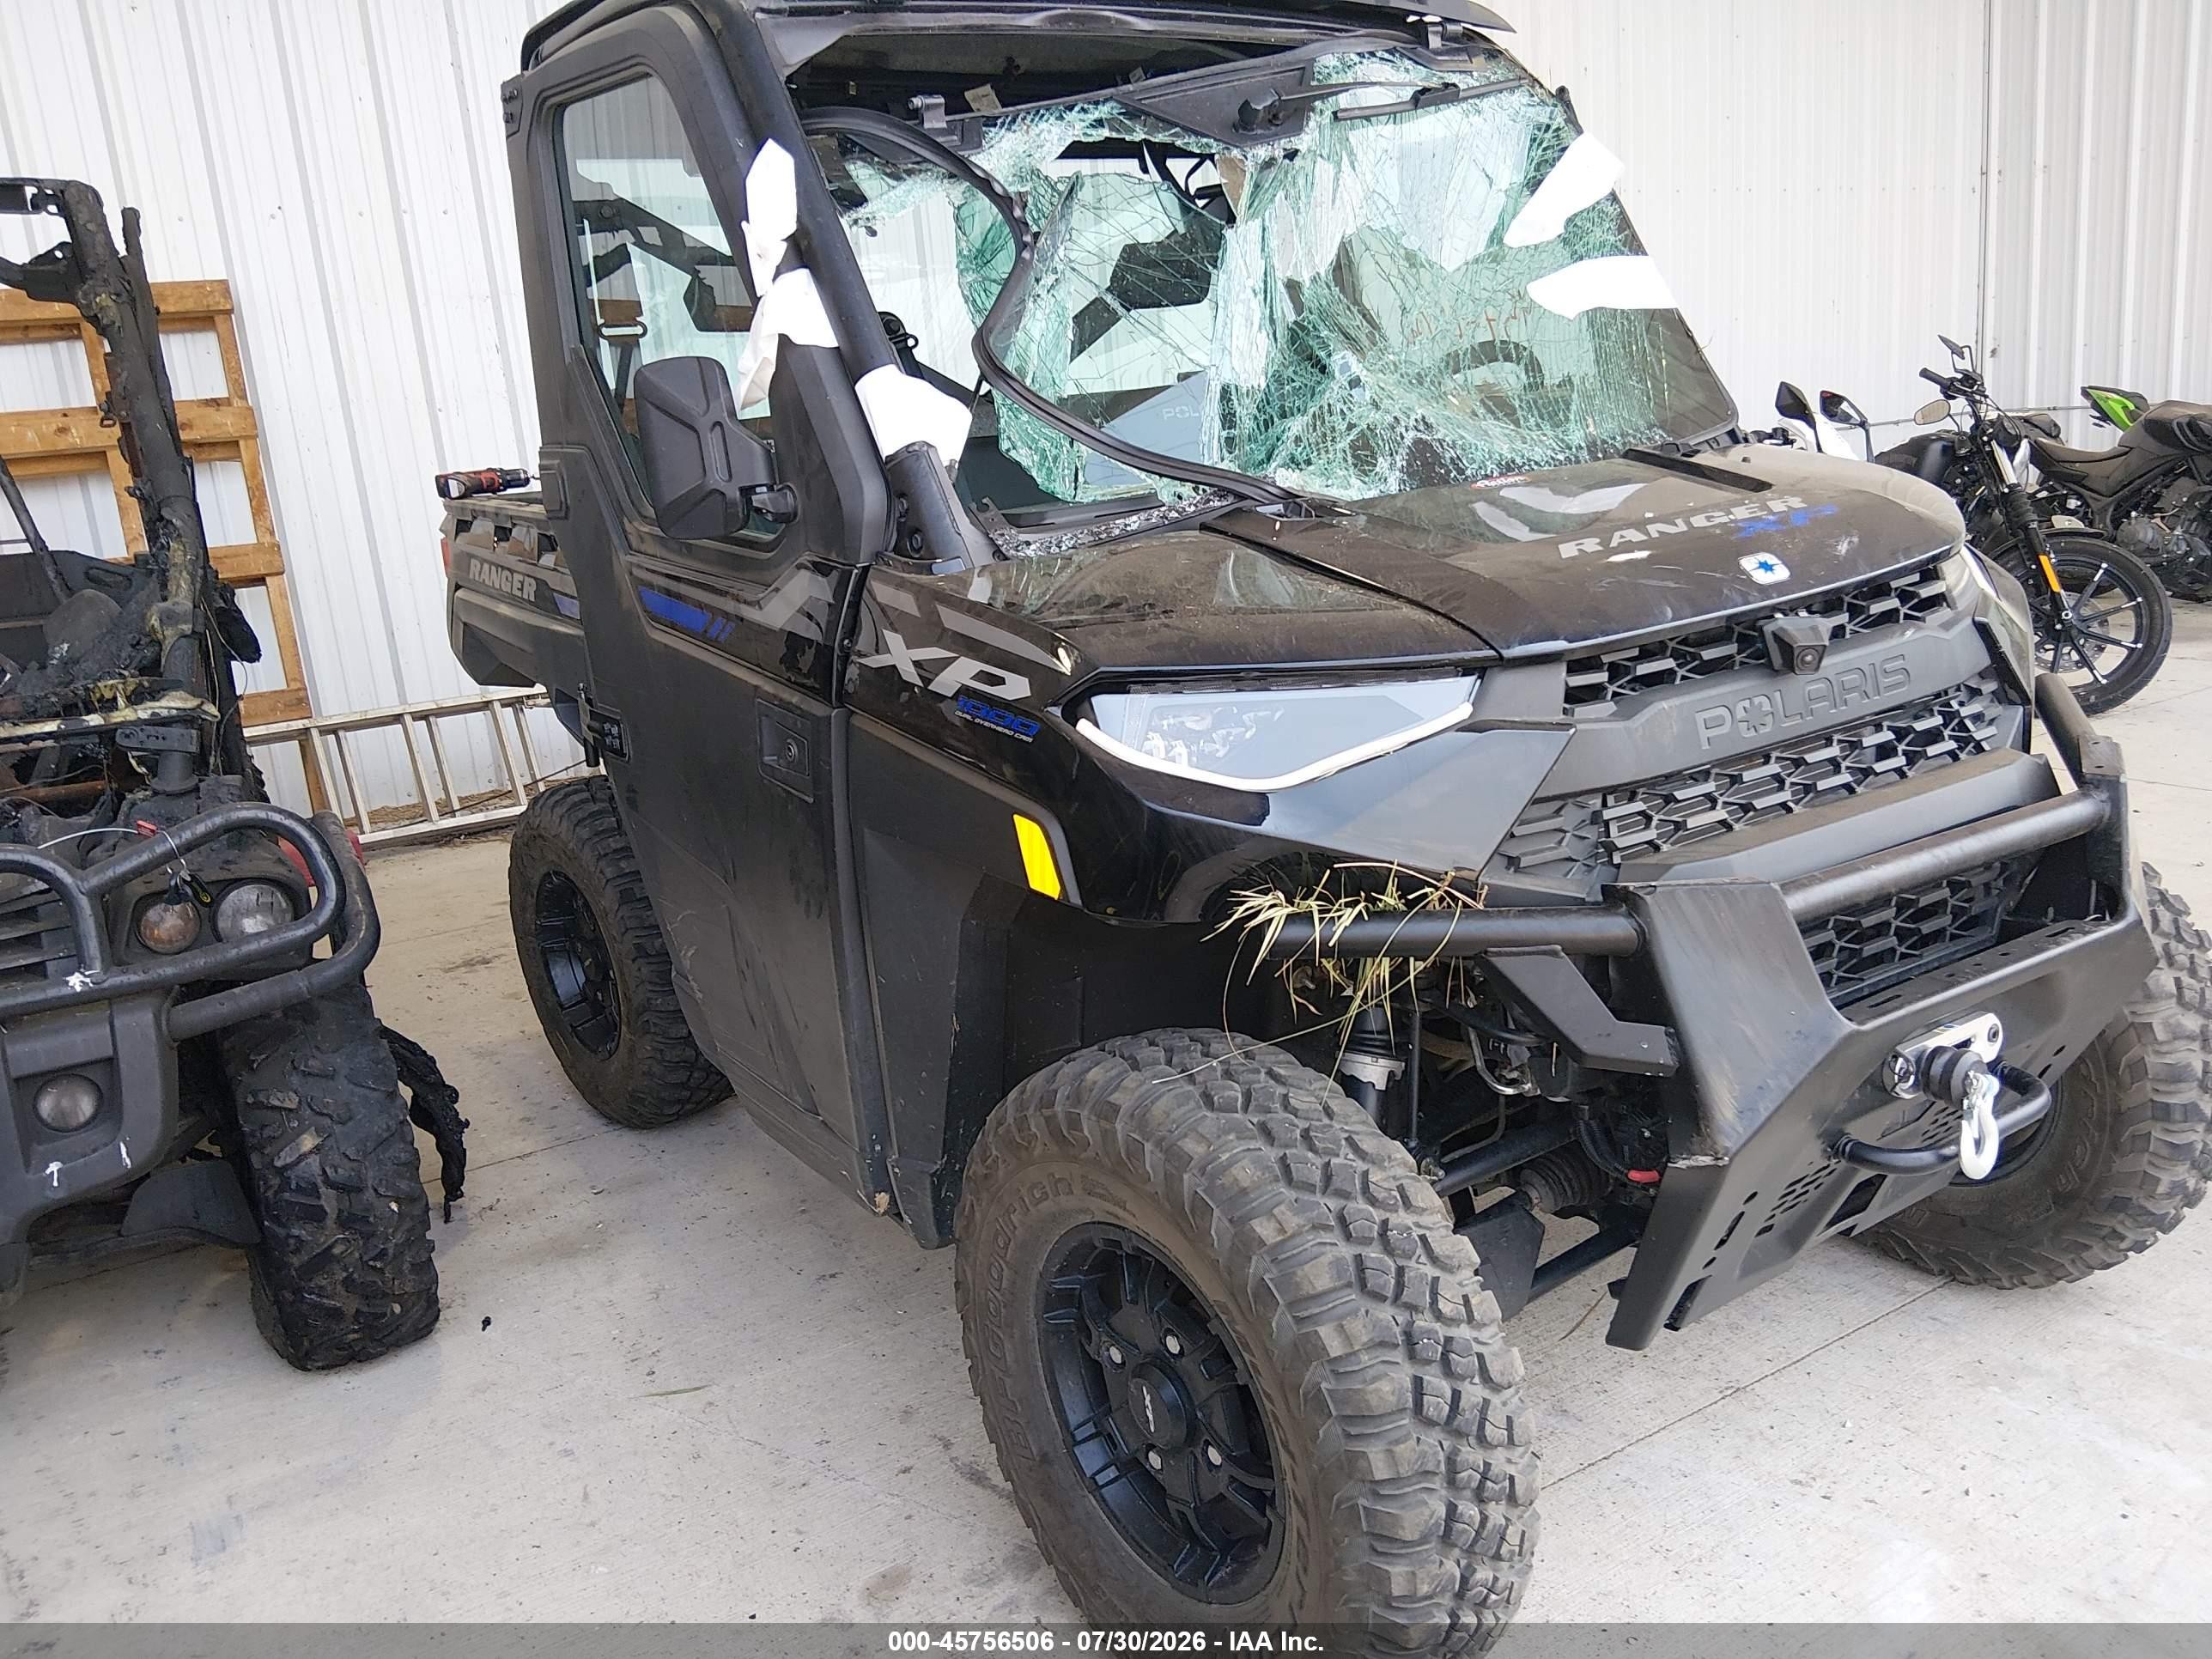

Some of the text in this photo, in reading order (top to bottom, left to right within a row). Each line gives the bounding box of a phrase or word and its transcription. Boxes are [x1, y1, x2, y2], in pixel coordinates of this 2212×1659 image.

[1558, 495, 1808, 560] RANGER
[469, 557, 538, 602] RANGER
[855, 629, 1031, 702] XP
[954, 709, 975, 722] DUAL
[974, 718, 1015, 737] OVERHEAD
[956, 694, 1042, 737] 1000
[1694, 653, 1911, 750] POLARIS
